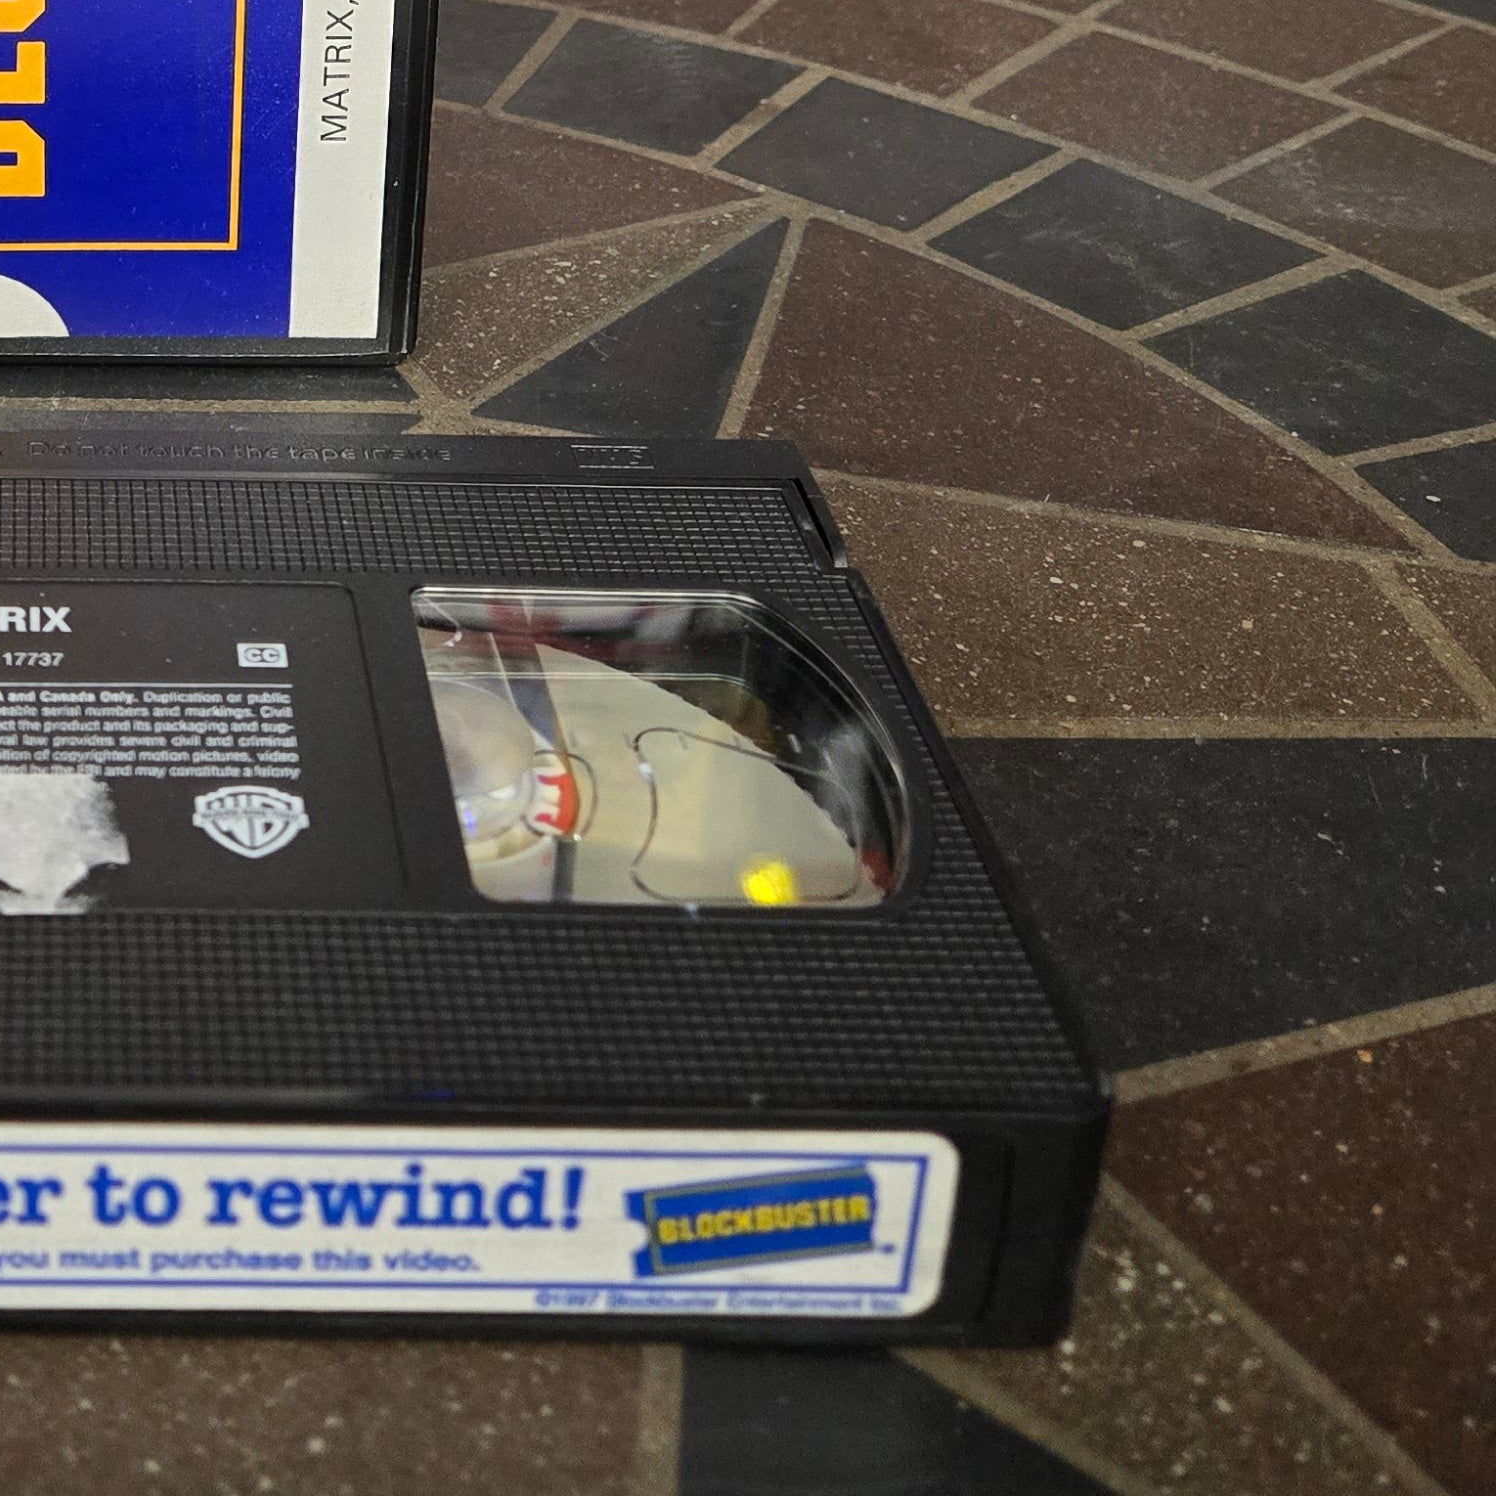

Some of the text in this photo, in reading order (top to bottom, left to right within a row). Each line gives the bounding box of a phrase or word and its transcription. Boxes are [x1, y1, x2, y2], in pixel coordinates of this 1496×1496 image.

[289, 444, 356, 462] tape
[2, 650, 65, 668] 17737
[243, 646, 281, 664] CC
[85, 1162, 183, 1228] to
[206, 1161, 586, 1231] rewind!
[656, 1195, 871, 1245] BLOCKBUSTER
[58, 1247, 141, 1271] must
[150, 1247, 302, 1273] purchase
[312, 1248, 373, 1272] this
[383, 1248, 481, 1273] video.
